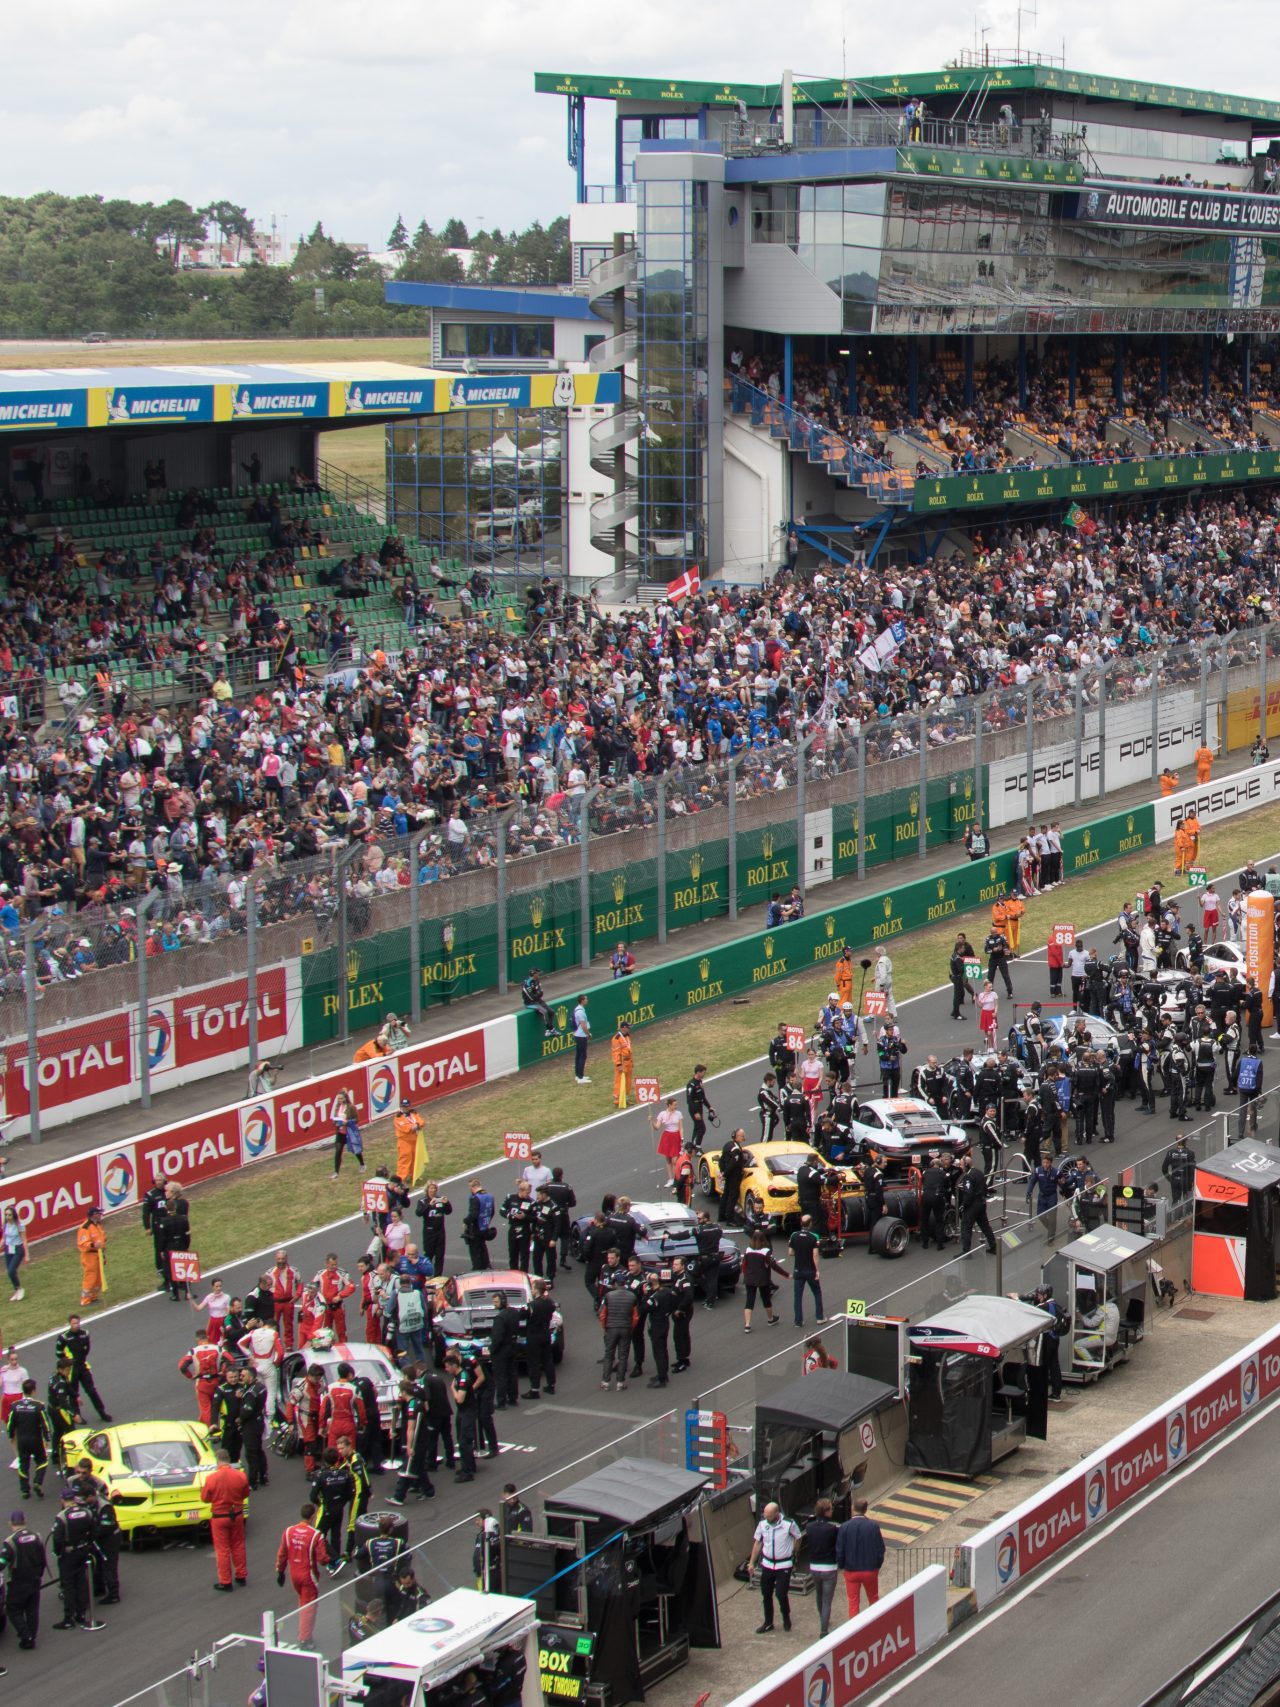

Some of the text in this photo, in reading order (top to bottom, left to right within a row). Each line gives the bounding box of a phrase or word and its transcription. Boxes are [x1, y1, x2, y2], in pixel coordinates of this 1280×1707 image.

[556, 84, 579, 93] ROLEX
[609, 88, 632, 96] ROLEX
[661, 91, 684, 99] ROLEX
[834, 90, 858, 98] ROLX
[935, 83, 960, 91] ROLEX
[1106, 194, 1187, 219] AUTOMOBILE
[1190, 201, 1220, 221] CLUB
[1223, 203, 1240, 222] DE
[253, 395, 317, 410] MICHELIN
[364, 391, 423, 406] MICHELIN
[467, 387, 520, 401] MICHELIN
[0, 402, 73, 421] MICHELIN
[131, 398, 200, 414] MICHELIN
[1103, 480, 1119, 490] ROLEX
[1134, 477, 1149, 486] ROLEX
[1164, 474, 1178, 483] ROLEX
[1003, 489, 1020, 499] ROLEX
[1037, 486, 1054, 496] ROLEX
[1071, 483, 1087, 492] ROLEX
[929, 495, 947, 506] ROLEX
[966, 492, 984, 502] ROLEX
[1005, 751, 1100, 793] PORSCHE
[1170, 778, 1260, 826] PORSCHE
[895, 817, 932, 842] ROLX
[1119, 834, 1144, 851] ROLEX
[1074, 849, 1100, 868] ROLEX
[747, 860, 789, 887] ROLEX
[1190, 874, 1206, 886] 94
[673, 881, 719, 910] ROLEX
[979, 880, 1006, 901] ROLEX
[927, 899, 956, 921] ROLEX
[594, 904, 644, 934] ROLEX
[872, 917, 903, 940] ROLEX
[1054, 924, 1074, 932] MOTUL
[512, 927, 566, 959] ROLEX
[1055, 932, 1073, 945] 88
[814, 936, 846, 960] ROLEX
[421, 953, 476, 987] ROLEX
[752, 957, 788, 983] ROLEX
[965, 966, 981, 979] 89
[323, 982, 383, 1017] ROLEX
[687, 980, 723, 1007] ROLEX
[865, 991, 886, 1000] MOTUL
[866, 1000, 884, 1014] 77
[183, 992, 280, 1041] TOTAL
[617, 1003, 655, 1030] ROLEX
[542, 1031, 577, 1057] ROLE
[788, 1035, 804, 1050] 86
[14, 1038, 124, 1088] TOTAL
[403, 1051, 478, 1092] TOTAL
[635, 1077, 658, 1085] MOTUL
[637, 1087, 657, 1101] 84
[504, 1132, 531, 1141] MOTUL
[145, 1131, 235, 1178] TOTAL
[506, 1143, 529, 1158] 78
[362, 1183, 387, 1192] MOTUL
[0, 1181, 93, 1227] TOTAL
[365, 1195, 386, 1212] 56
[171, 1251, 198, 1262] MOTUL
[173, 1262, 198, 1281] 54
[848, 1302, 864, 1315] 50
[976, 1344, 990, 1354] 50
[1190, 1391, 1239, 1435] TOTAL
[1111, 1445, 1164, 1489] TOTAL
[1023, 1503, 1083, 1556] TOTAL
[538, 1649, 571, 1673] BOX
[838, 1626, 910, 1686] TOTAL
[553, 1674, 581, 1698] THROUGH
